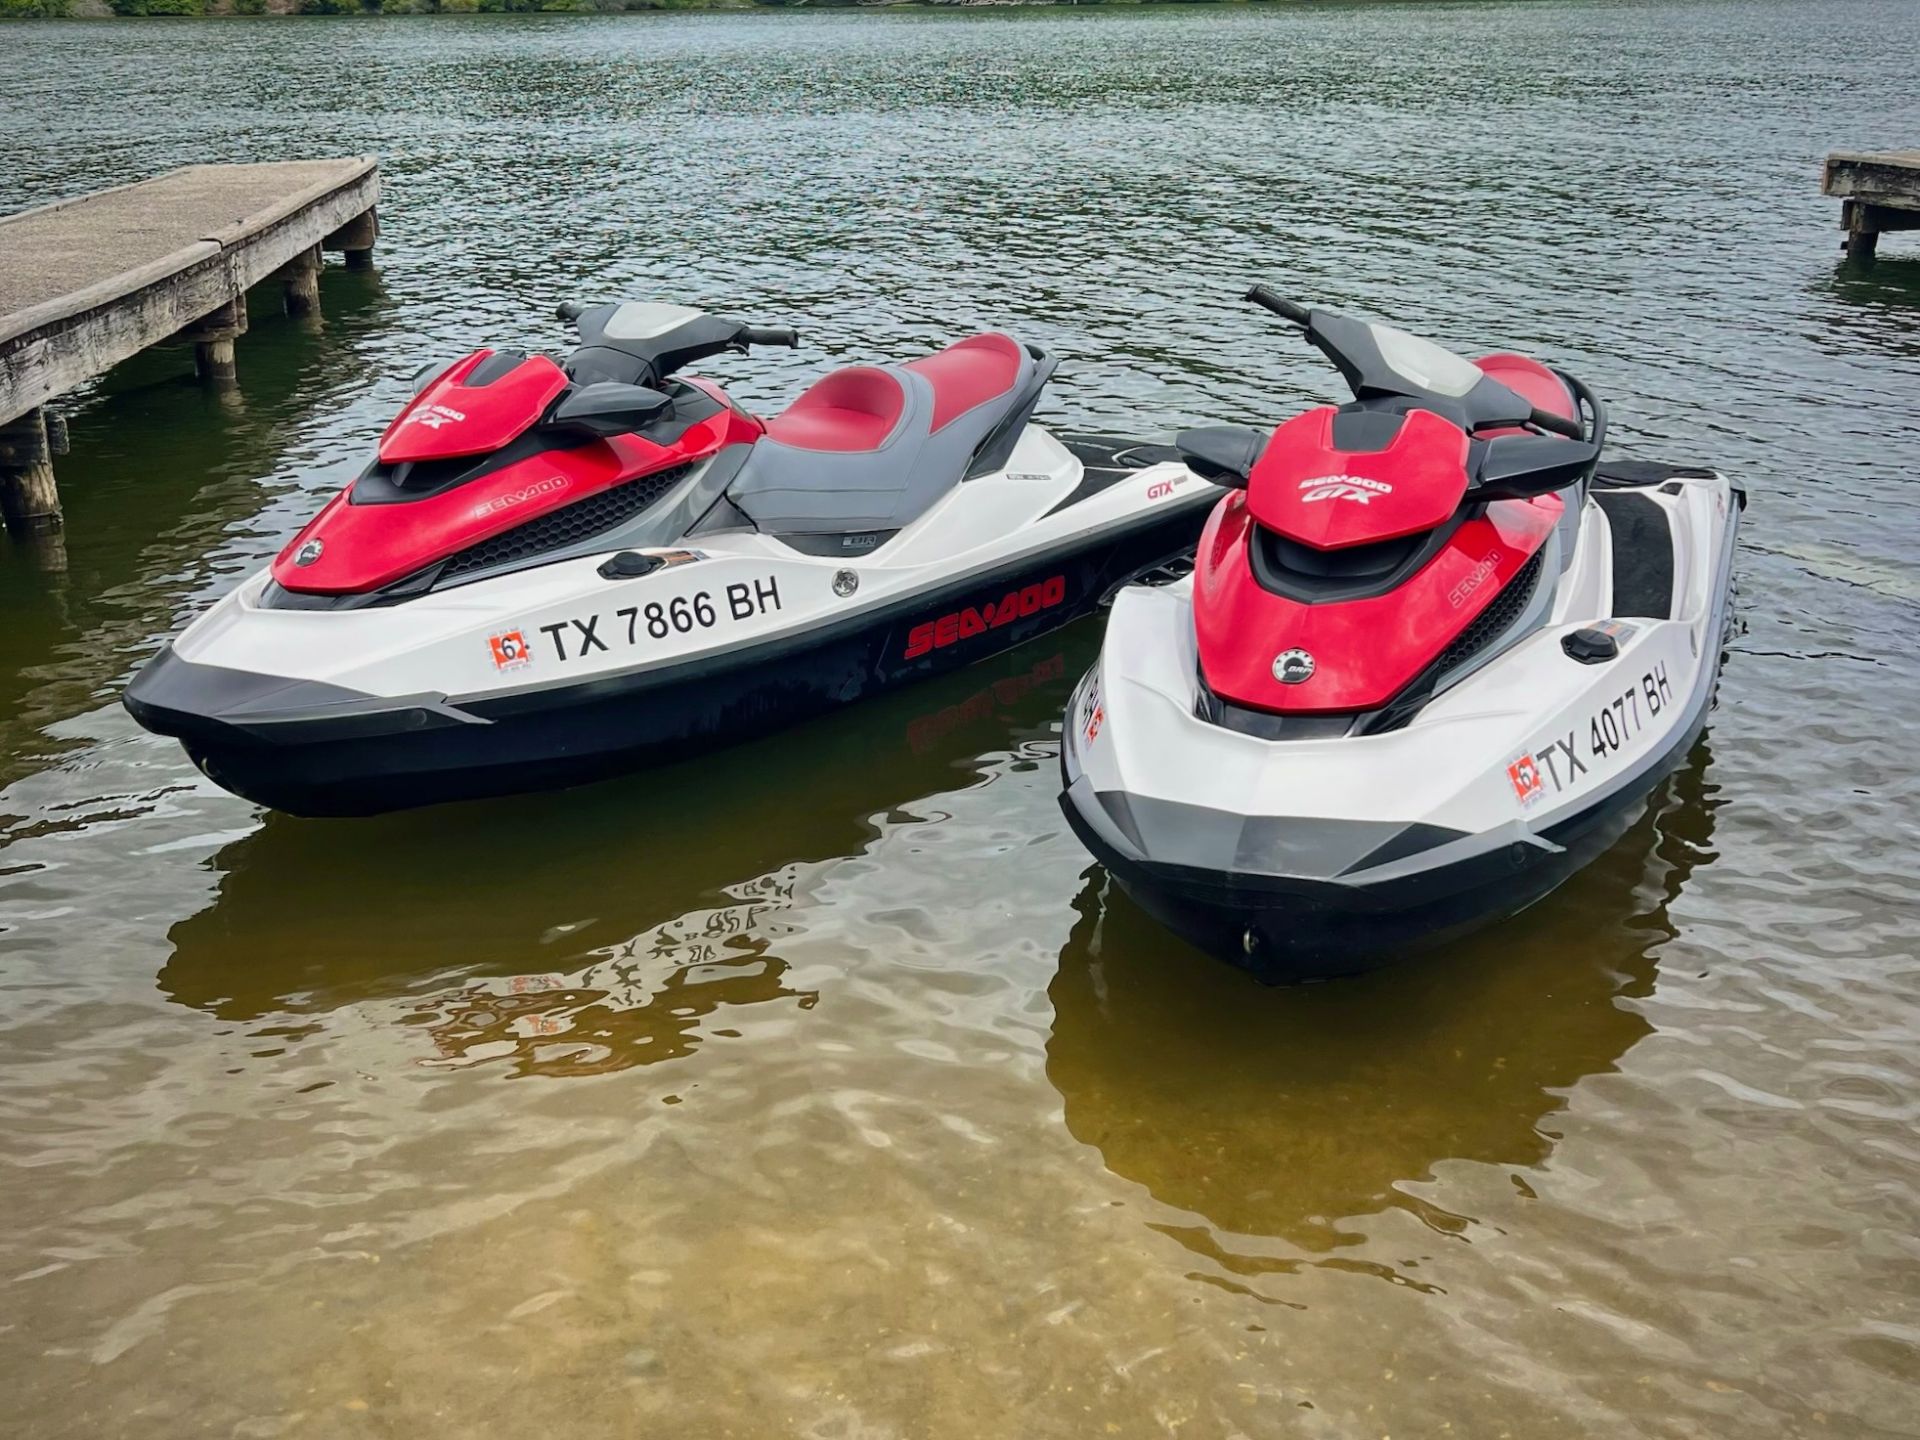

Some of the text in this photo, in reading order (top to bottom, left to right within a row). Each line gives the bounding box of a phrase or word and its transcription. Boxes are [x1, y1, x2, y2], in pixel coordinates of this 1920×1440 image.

[1147, 480, 1174, 500] GTX
[1302, 484, 1383, 505] GTX
[540, 575, 782, 661] TX 7866 BH
[501, 637, 516, 660] 6
[1536, 660, 1673, 792] TX 4077 BH
[1516, 763, 1532, 790] 6
